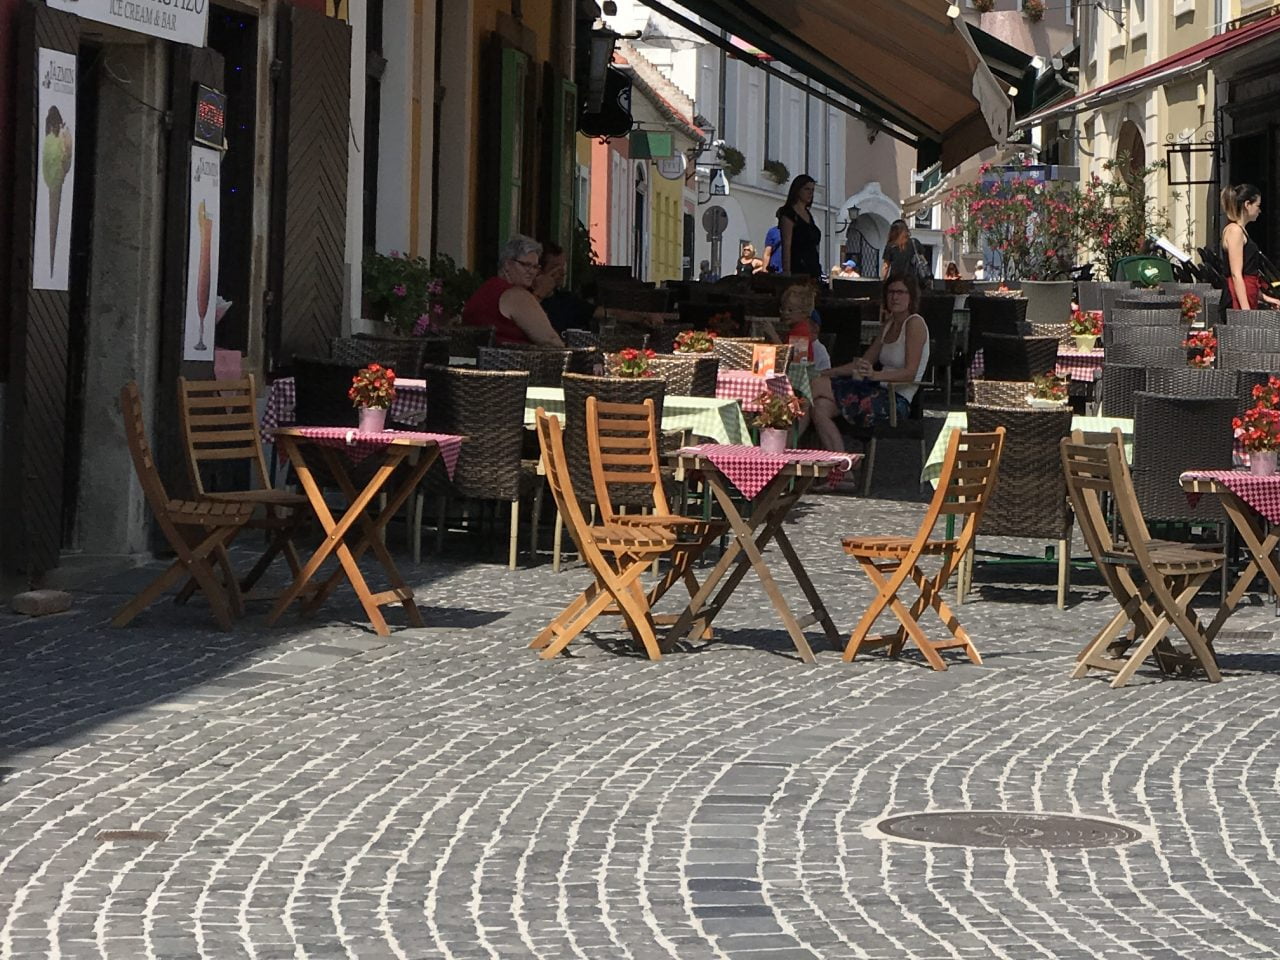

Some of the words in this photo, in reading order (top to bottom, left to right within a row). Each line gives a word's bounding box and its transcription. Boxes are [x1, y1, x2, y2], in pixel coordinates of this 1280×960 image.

[125, 1, 153, 25] CREAM
[153, 9, 160, 25] &
[161, 11, 177, 31] BAR
